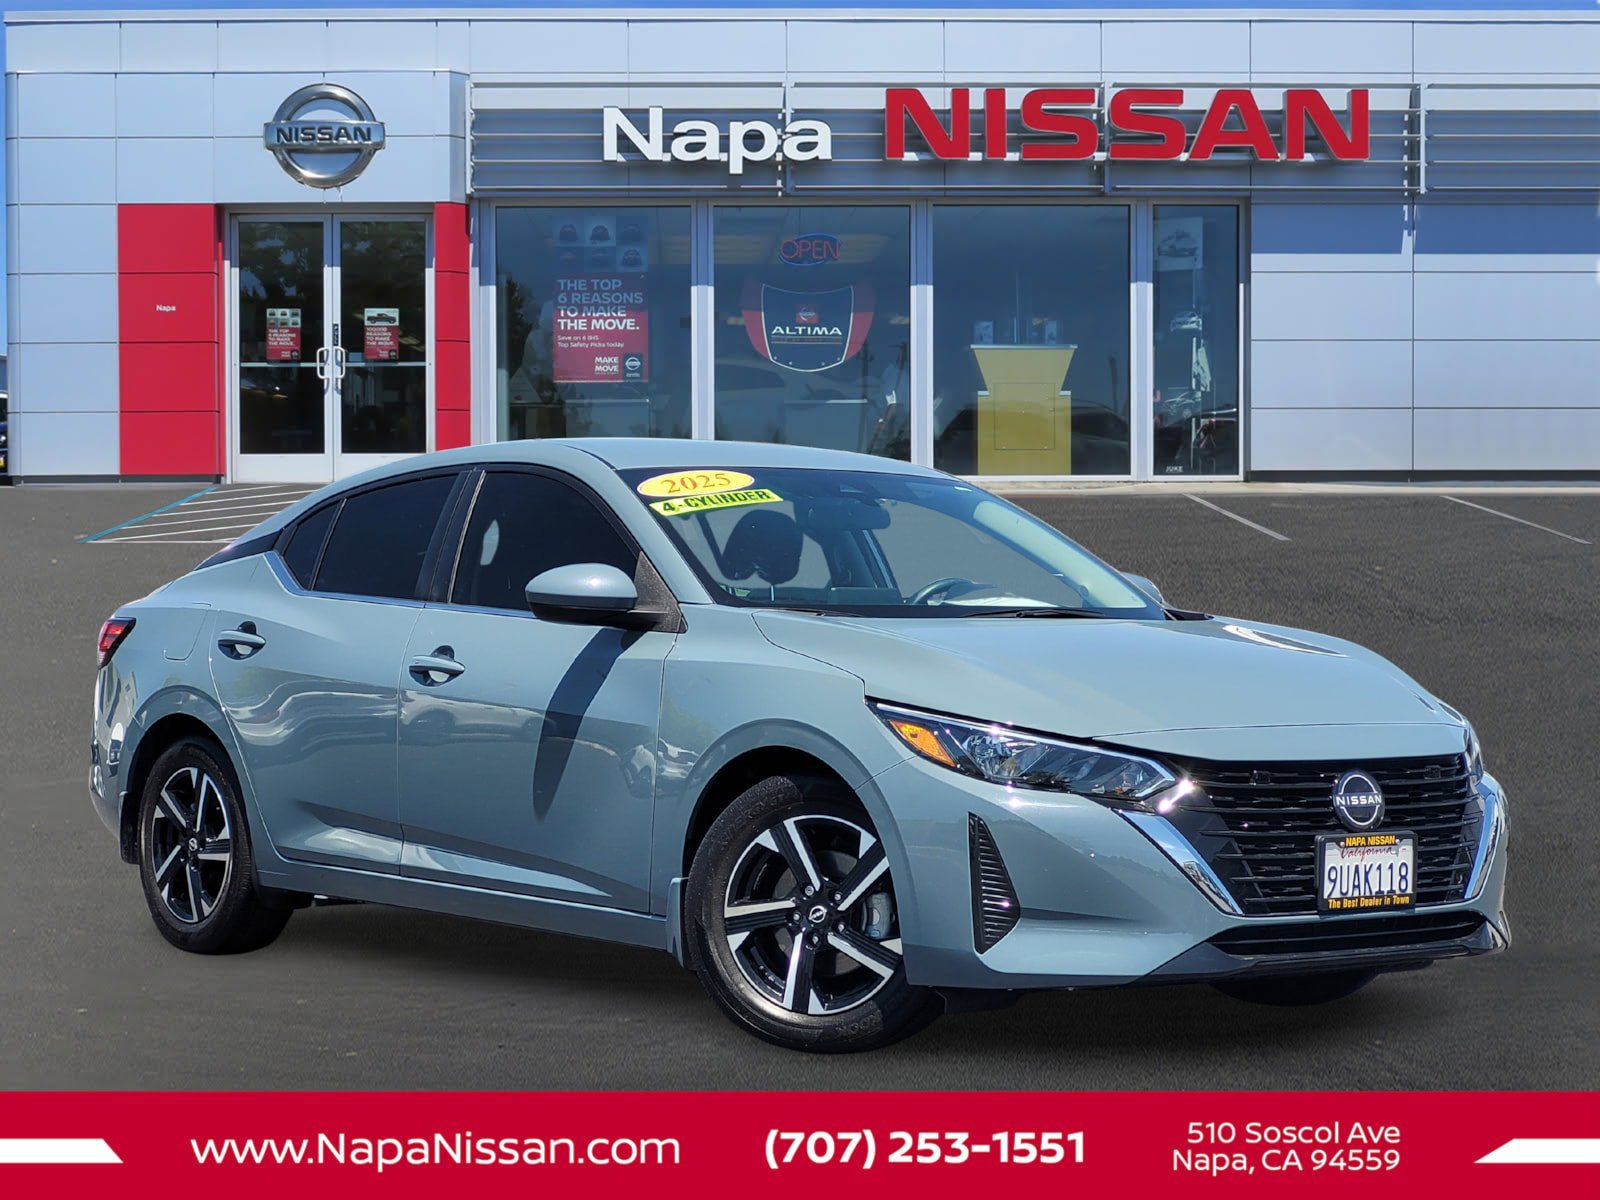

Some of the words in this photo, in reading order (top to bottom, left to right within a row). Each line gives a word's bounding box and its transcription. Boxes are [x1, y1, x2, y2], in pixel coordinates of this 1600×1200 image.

[276, 126, 372, 143] NISSAN
[603, 106, 832, 174] Napa
[885, 88, 1370, 160] NISSAN
[780, 240, 841, 260] OPEN
[558, 279, 587, 291] THE
[591, 279, 622, 291] TOP
[558, 292, 568, 304] 6
[572, 292, 644, 304] REASONS
[156, 304, 176, 312] Napa
[558, 305, 578, 317] TO
[582, 305, 626, 317] MAKE
[558, 318, 587, 330] THE
[591, 318, 640, 330] MOVE.
[772, 326, 842, 335] ALTIMA
[661, 473, 731, 494] 2025
[662, 490, 770, 511] 4-CYLINDER
[1336, 795, 1381, 805] NISSAN
[1346, 837, 1366, 847] NAPA
[1367, 835, 1396, 846] NISSAN
[1341, 846, 1398, 861] California
[1327, 862, 1409, 897] 9UAK118
[1328, 899, 1341, 909] The
[1343, 898, 1358, 908] Best
[1360, 897, 1382, 907] Dealer
[1384, 896, 1391, 905] in
[1392, 895, 1410, 905] Town
